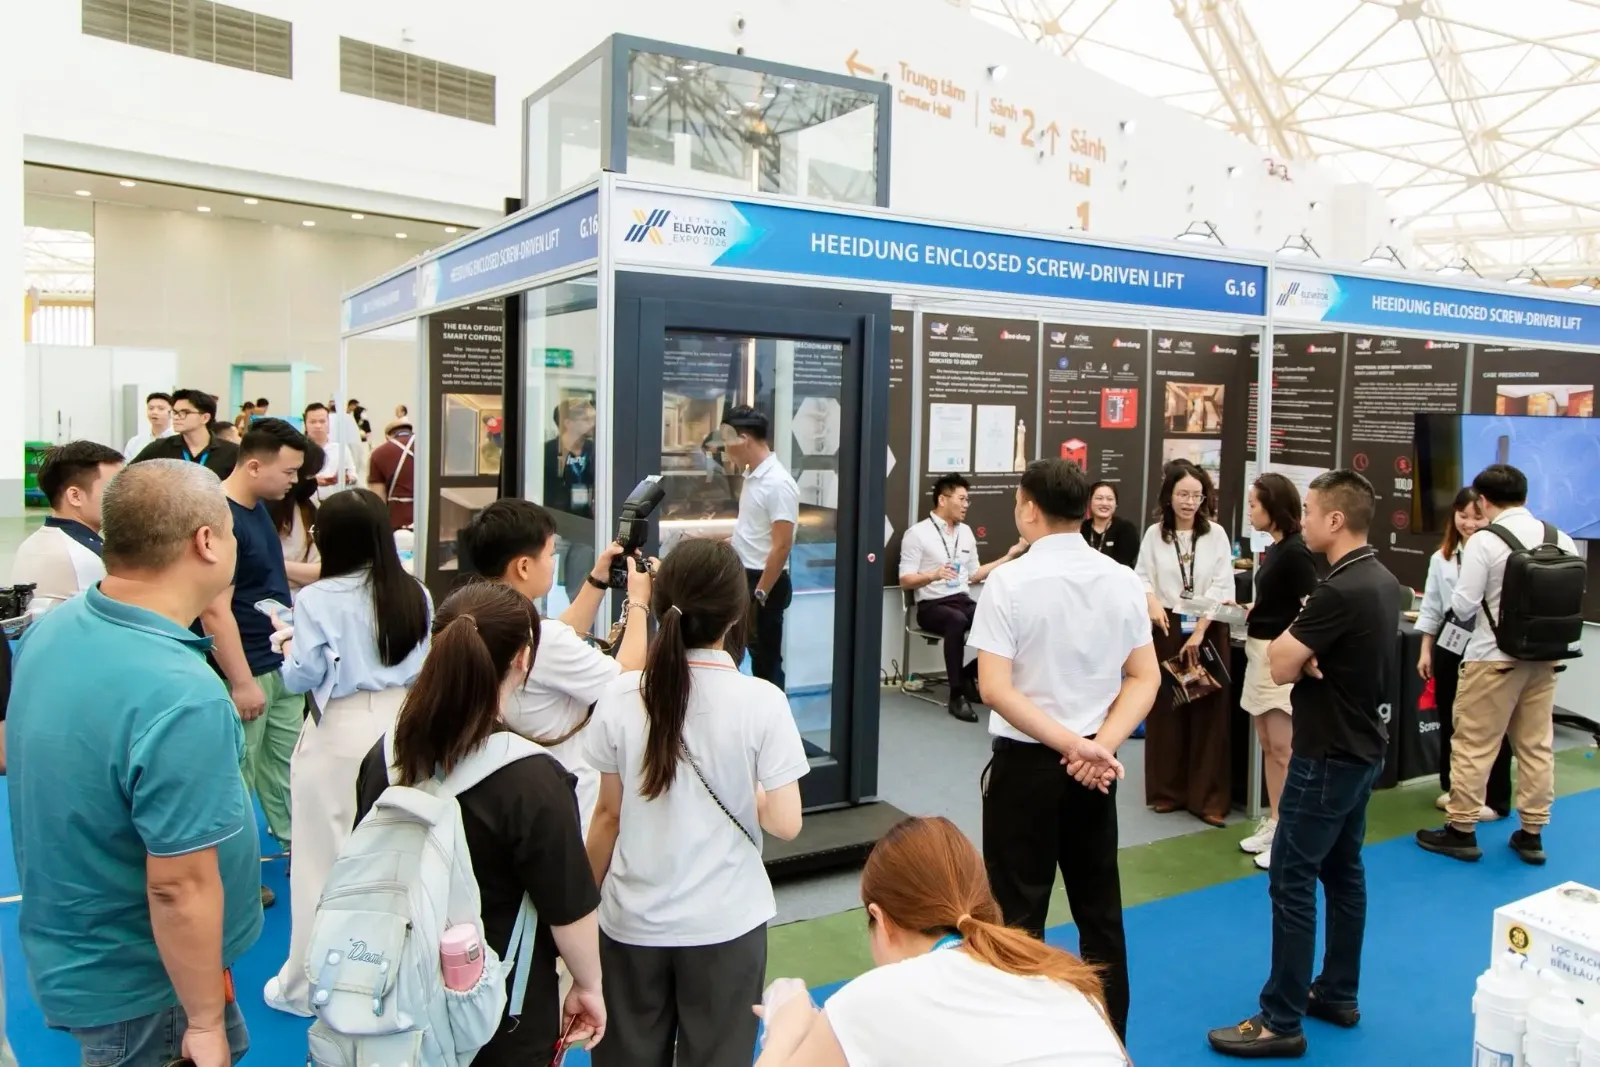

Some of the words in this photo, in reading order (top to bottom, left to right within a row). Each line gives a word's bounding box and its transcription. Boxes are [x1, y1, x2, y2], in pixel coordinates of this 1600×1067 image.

[898, 60, 938, 96] Trung
[898, 89, 931, 112] Center
[933, 100, 952, 119] Hall
[989, 121, 1006, 138] Hall
[1021, 108, 1035, 148] 2
[1069, 161, 1091, 187] Hall
[579, 213, 597, 239] G.16
[1076, 200, 1090, 232] 1
[545, 228, 560, 251] LIFT
[673, 222, 726, 237] ELEVATOR
[673, 234, 700, 245] EXPO
[811, 232, 919, 263] HEEIDUNG
[925, 245, 1022, 273] ENCLOSED
[1026, 256, 1150, 287] SCREW-DRIVEN
[1153, 272, 1185, 290] LIFT
[1224, 278, 1257, 298] G.16
[1371, 295, 1431, 315] HEEIDUNG
[1433, 302, 1488, 321] ENCLOSED
[1489, 308, 1561, 329] SCREW-DRIVEN
[1562, 317, 1582, 330] LIFT
[442, 332, 468, 340] SMART
[443, 322, 457, 330] THE
[458, 323, 472, 331] ERA
